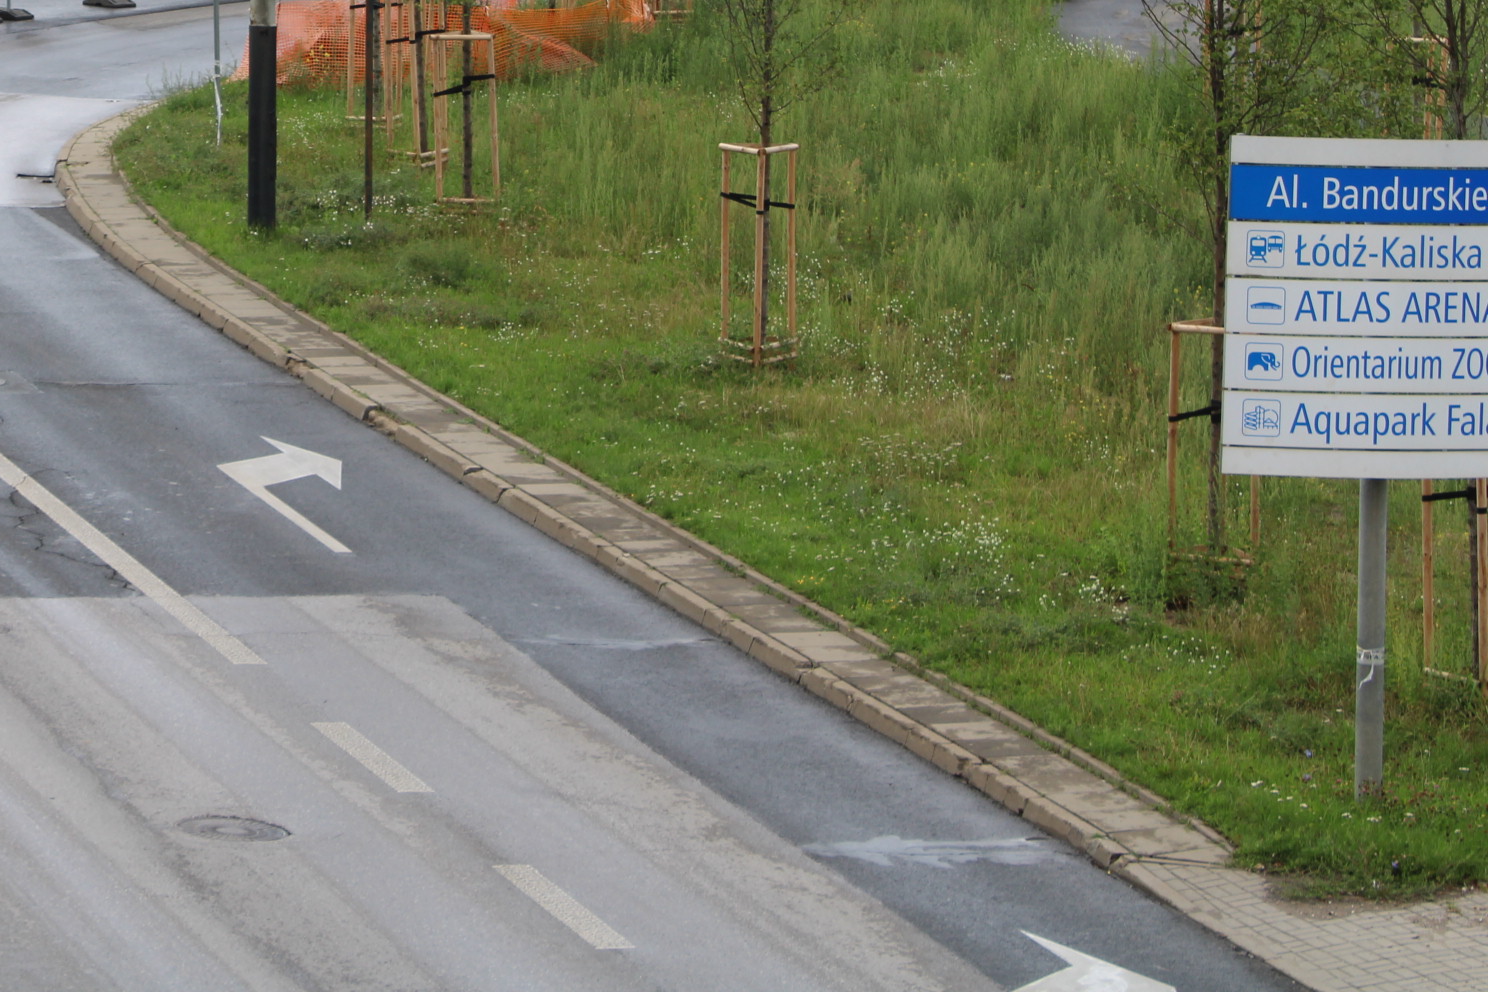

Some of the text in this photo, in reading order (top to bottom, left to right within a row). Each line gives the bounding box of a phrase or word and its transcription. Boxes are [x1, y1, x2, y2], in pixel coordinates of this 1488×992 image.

[1266, 174, 1488, 212] Al. Bandurskie
[1295, 233, 1482, 269] Łódź-Kaliska
[1294, 290, 1488, 324] ATLAS AREN
[1292, 345, 1488, 380] Orientarium ZO
[1289, 402, 1488, 445] Aquapark Fal
